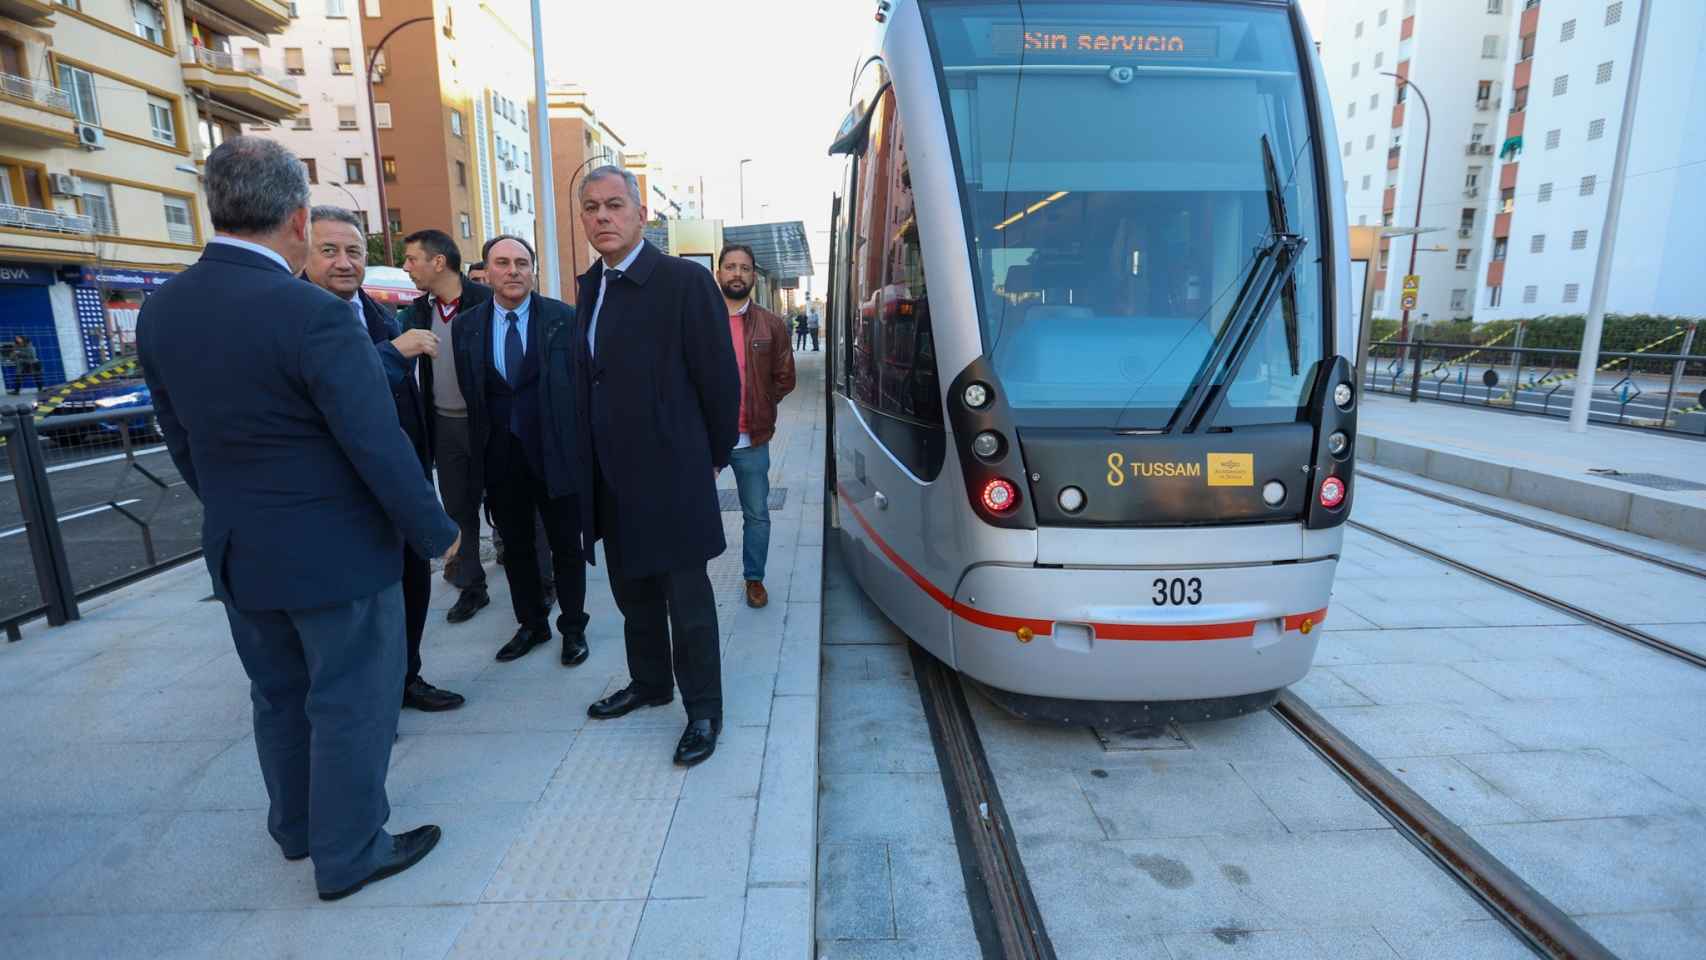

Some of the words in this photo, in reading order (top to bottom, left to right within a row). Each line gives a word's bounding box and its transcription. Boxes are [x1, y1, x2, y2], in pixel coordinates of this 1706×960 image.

[1024, 32, 1069, 49] Sin
[1078, 33, 1185, 52] servicio
[1131, 462, 1201, 477] TUSSAM
[1151, 577, 1202, 606] 303
